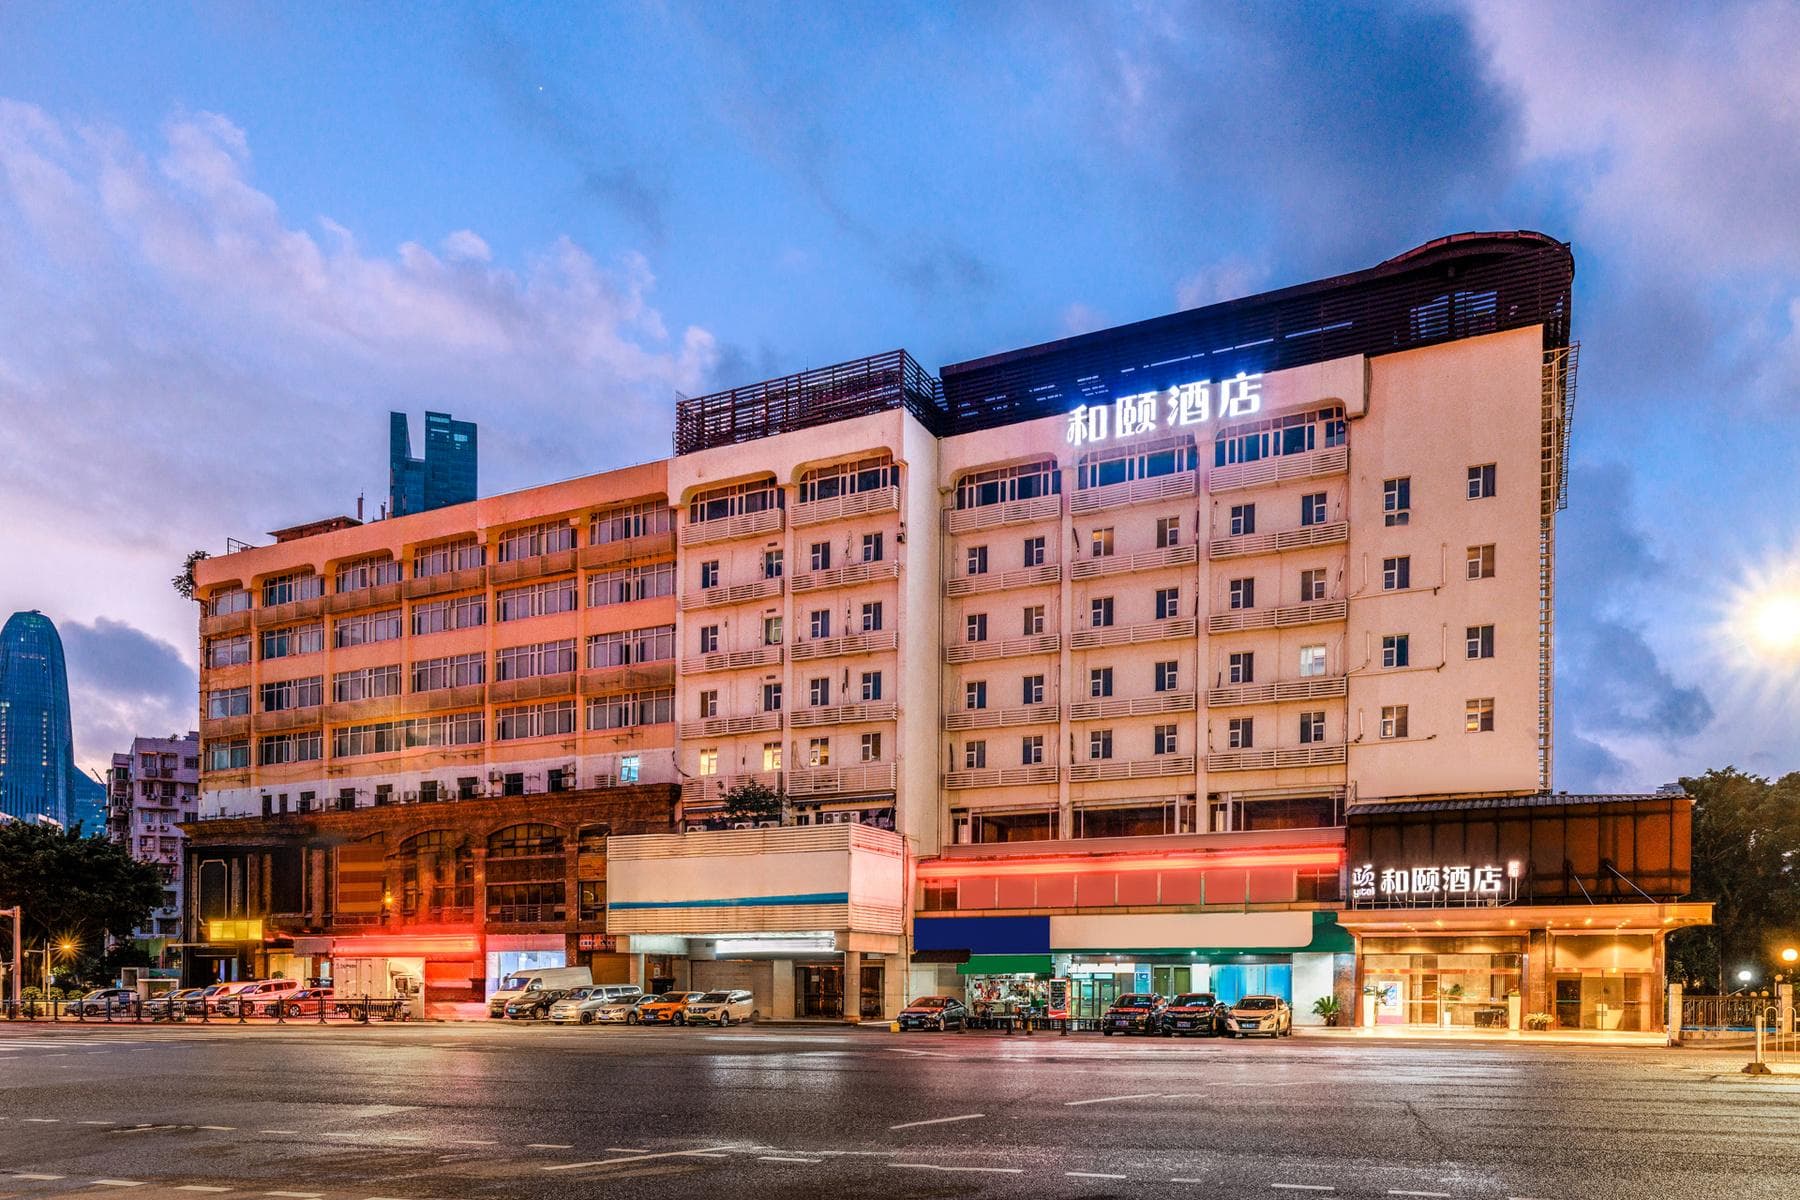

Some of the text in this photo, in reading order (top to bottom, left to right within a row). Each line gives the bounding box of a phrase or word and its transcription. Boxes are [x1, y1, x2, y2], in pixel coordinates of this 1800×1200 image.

[1067, 371, 1263, 446] 和颐酒店
[1381, 865, 1503, 894] 和颐酒店
